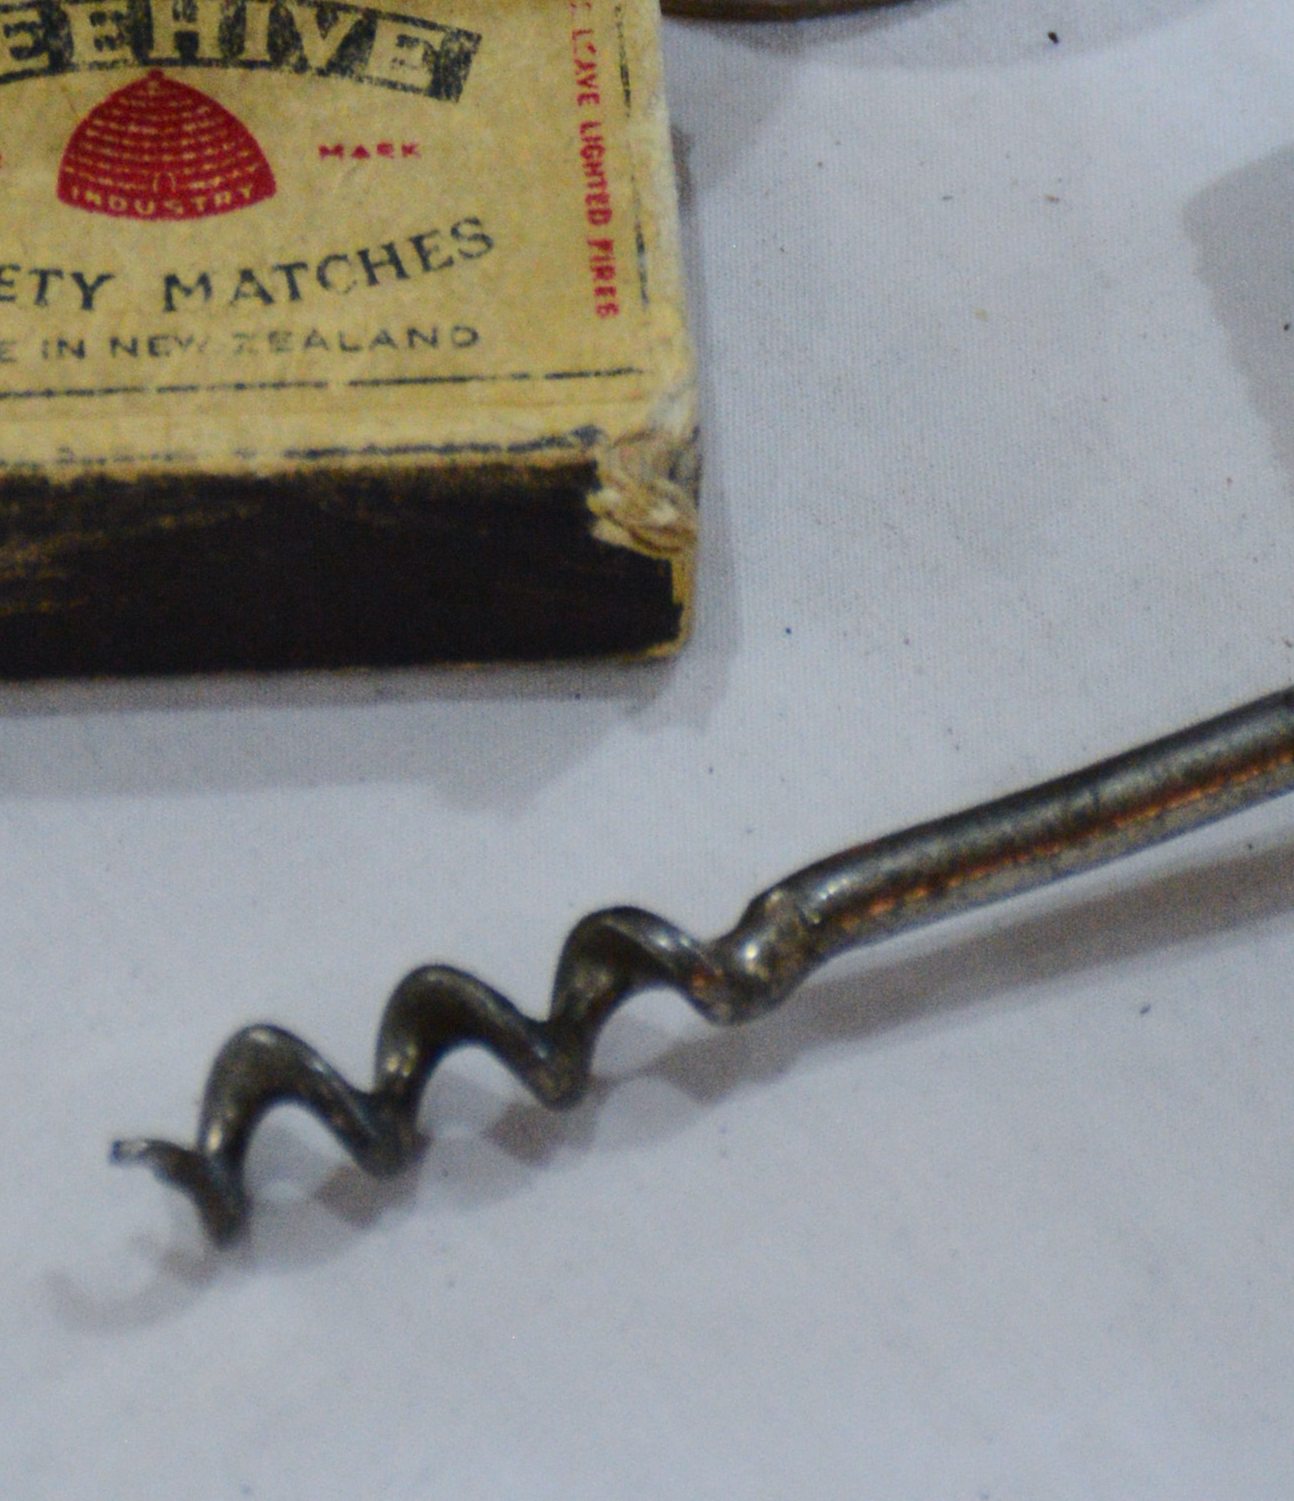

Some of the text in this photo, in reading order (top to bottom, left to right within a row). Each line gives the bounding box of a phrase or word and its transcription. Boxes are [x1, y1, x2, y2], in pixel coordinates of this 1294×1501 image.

[318, 141, 422, 162] MARK
[579, 120, 613, 225] LIGHTED
[70, 181, 258, 217] INDUSTRY
[159, 216, 497, 314] MATCHES
[587, 237, 620, 319] FIRES
[40, 339, 87, 361] IN
[109, 331, 212, 361] NEW
[234, 324, 483, 357] ZEALAND
